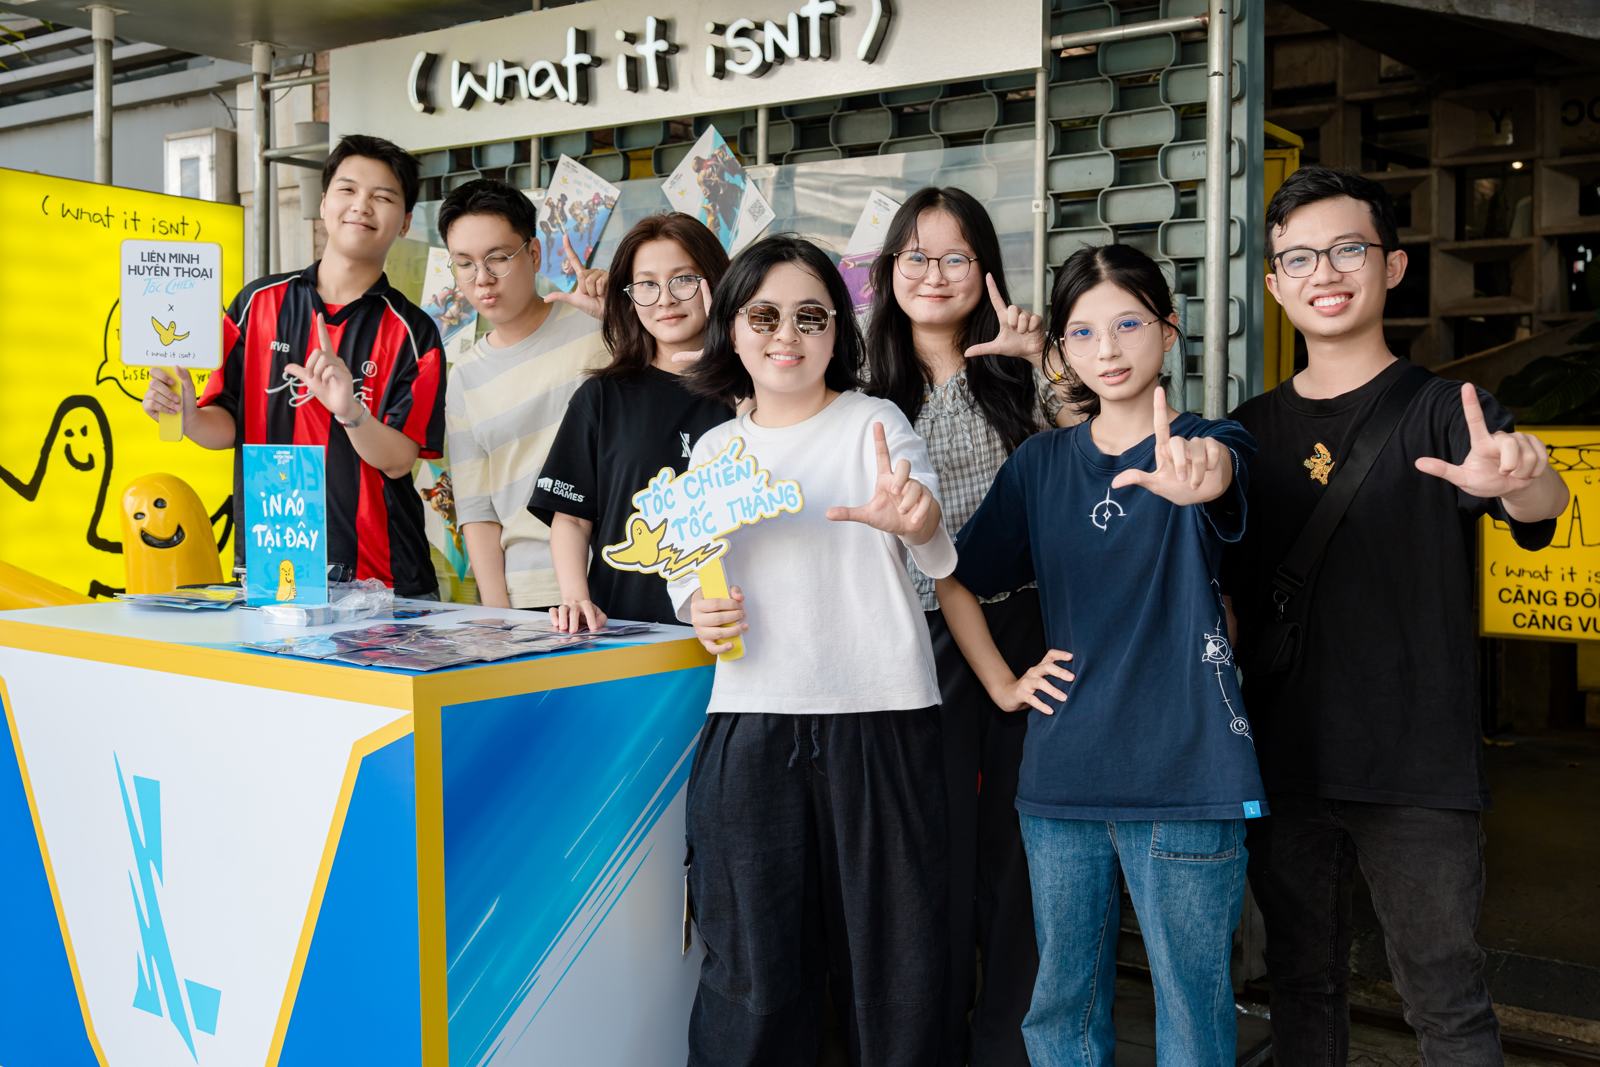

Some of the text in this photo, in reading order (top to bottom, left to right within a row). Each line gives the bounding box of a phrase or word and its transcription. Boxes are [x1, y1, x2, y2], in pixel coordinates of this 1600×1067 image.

[615, 15, 674, 92] it
[123, 210, 141, 231] it
[168, 252, 200, 265] MINH
[173, 267, 213, 280] THOẠI
[270, 341, 290, 352] RVB
[554, 479, 575, 491] RIOT
[552, 486, 585, 503] GAMES
[636, 472, 677, 518] TỐC
[670, 501, 717, 541] TỐC
[283, 521, 319, 551] ĐÂY
[1560, 566, 1577, 582] it
